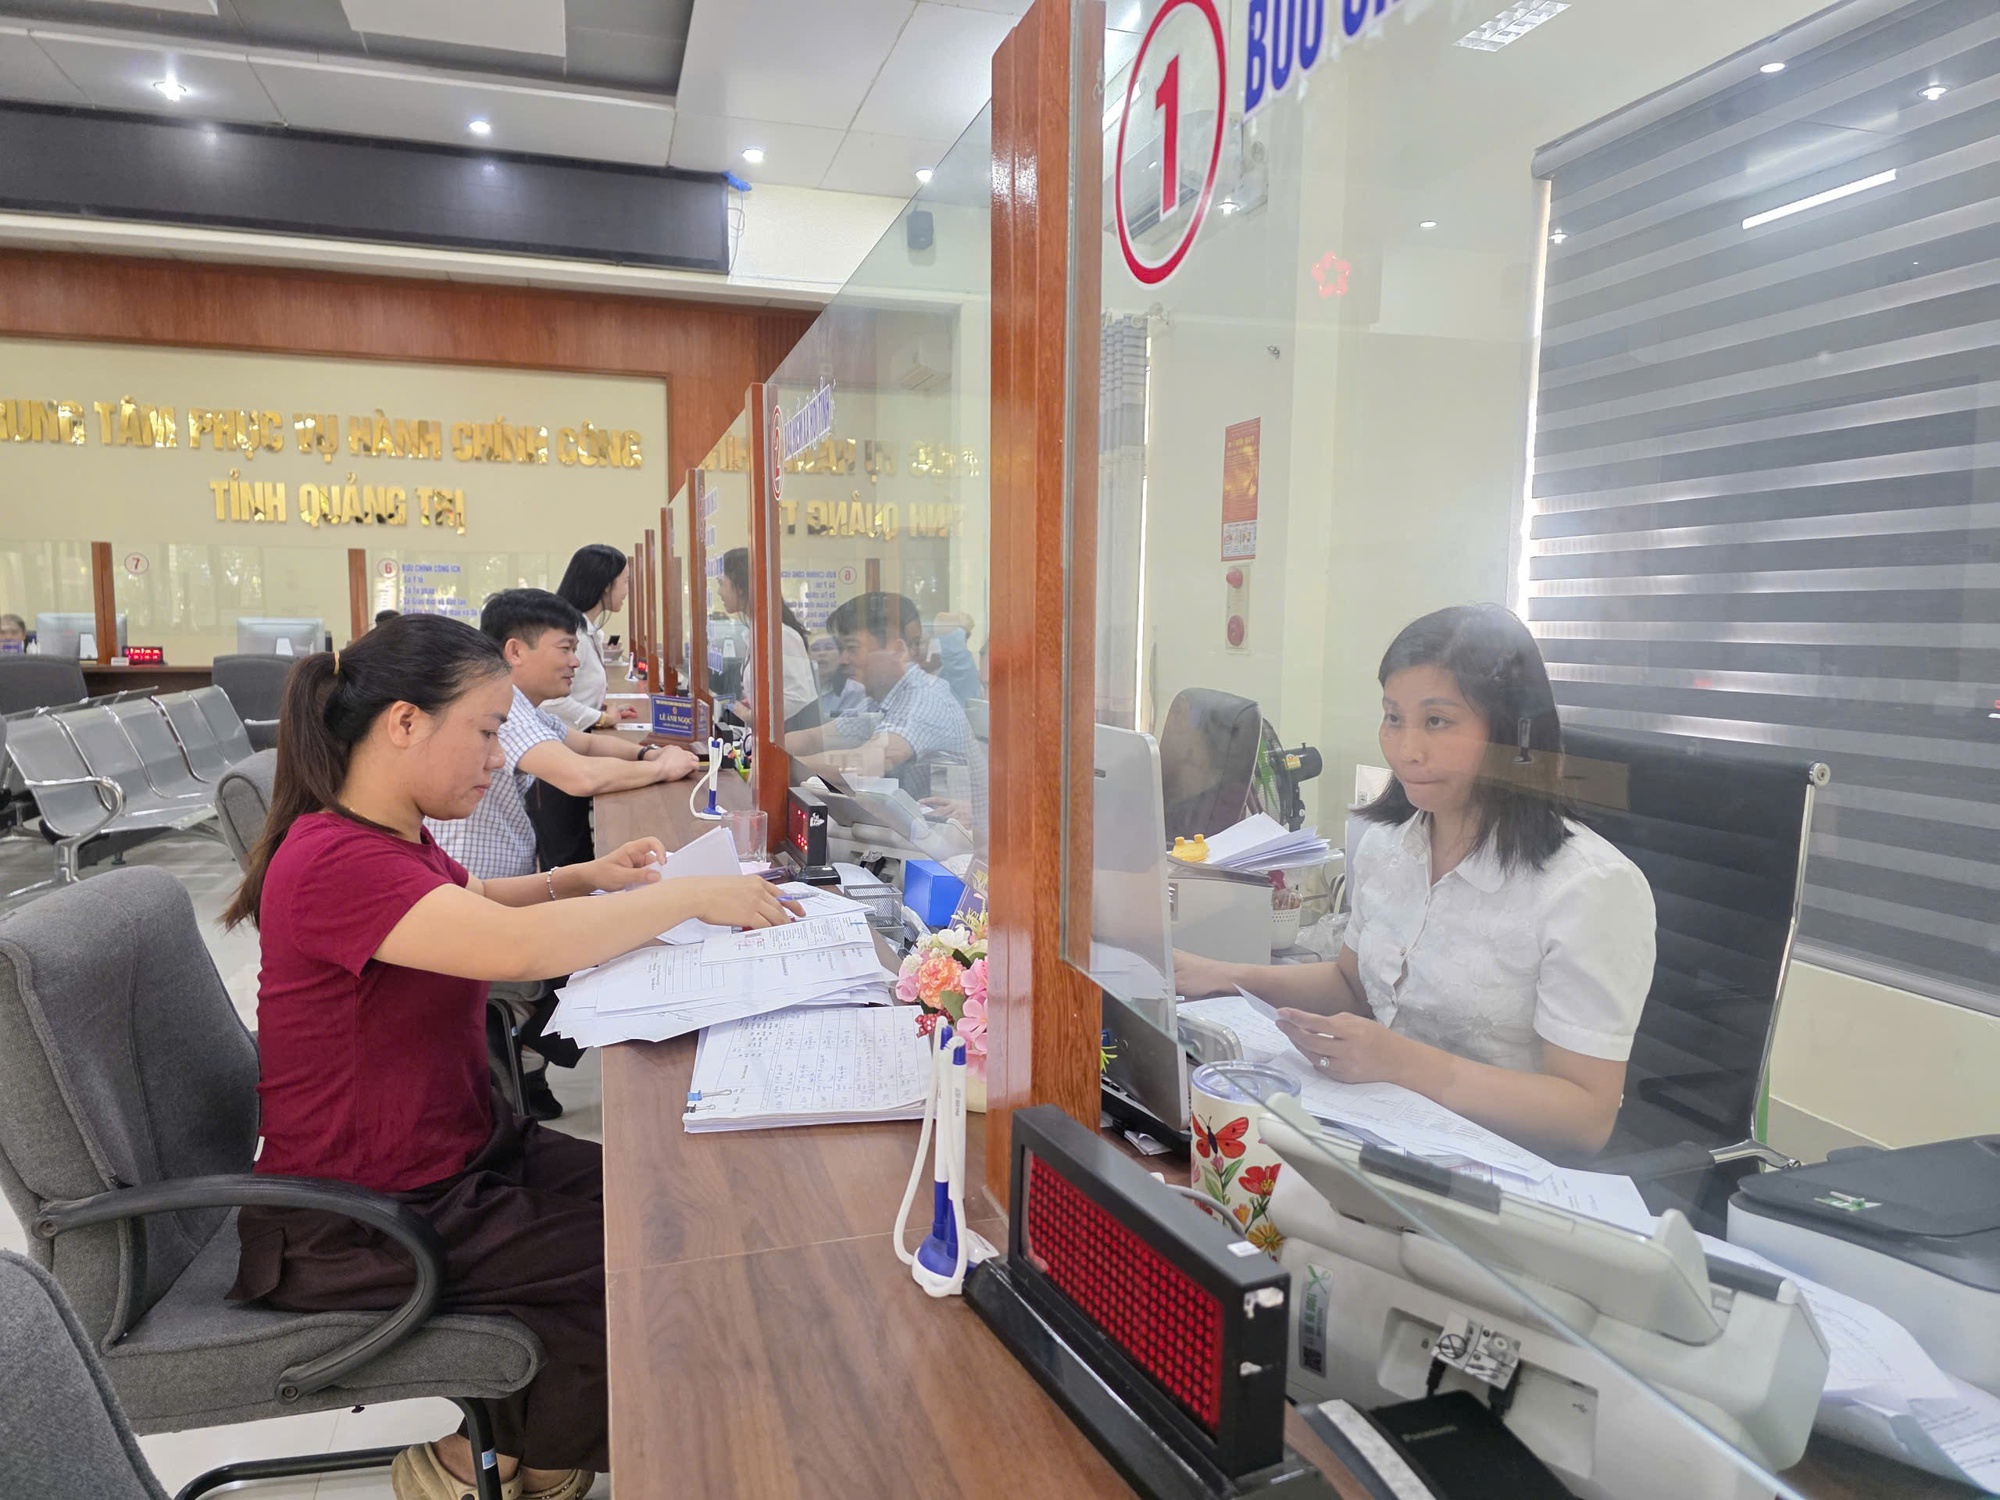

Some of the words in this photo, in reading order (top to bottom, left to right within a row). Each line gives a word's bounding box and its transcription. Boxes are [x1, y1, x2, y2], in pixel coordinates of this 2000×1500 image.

[1155, 53, 1179, 215] 1
[94, 395, 177, 448] TÂM
[188, 407, 284, 461] PHỤC
[293, 413, 339, 463] VỤ
[349, 408, 443, 460] HÀNH
[452, 415, 549, 465] CHÍNH
[557, 419, 643, 469] CÔNG
[209, 468, 286, 523] TỈNH
[299, 471, 407, 528] QUẢNG
[414, 486, 466, 535] TRỊ
[385, 562, 392, 574] 6
